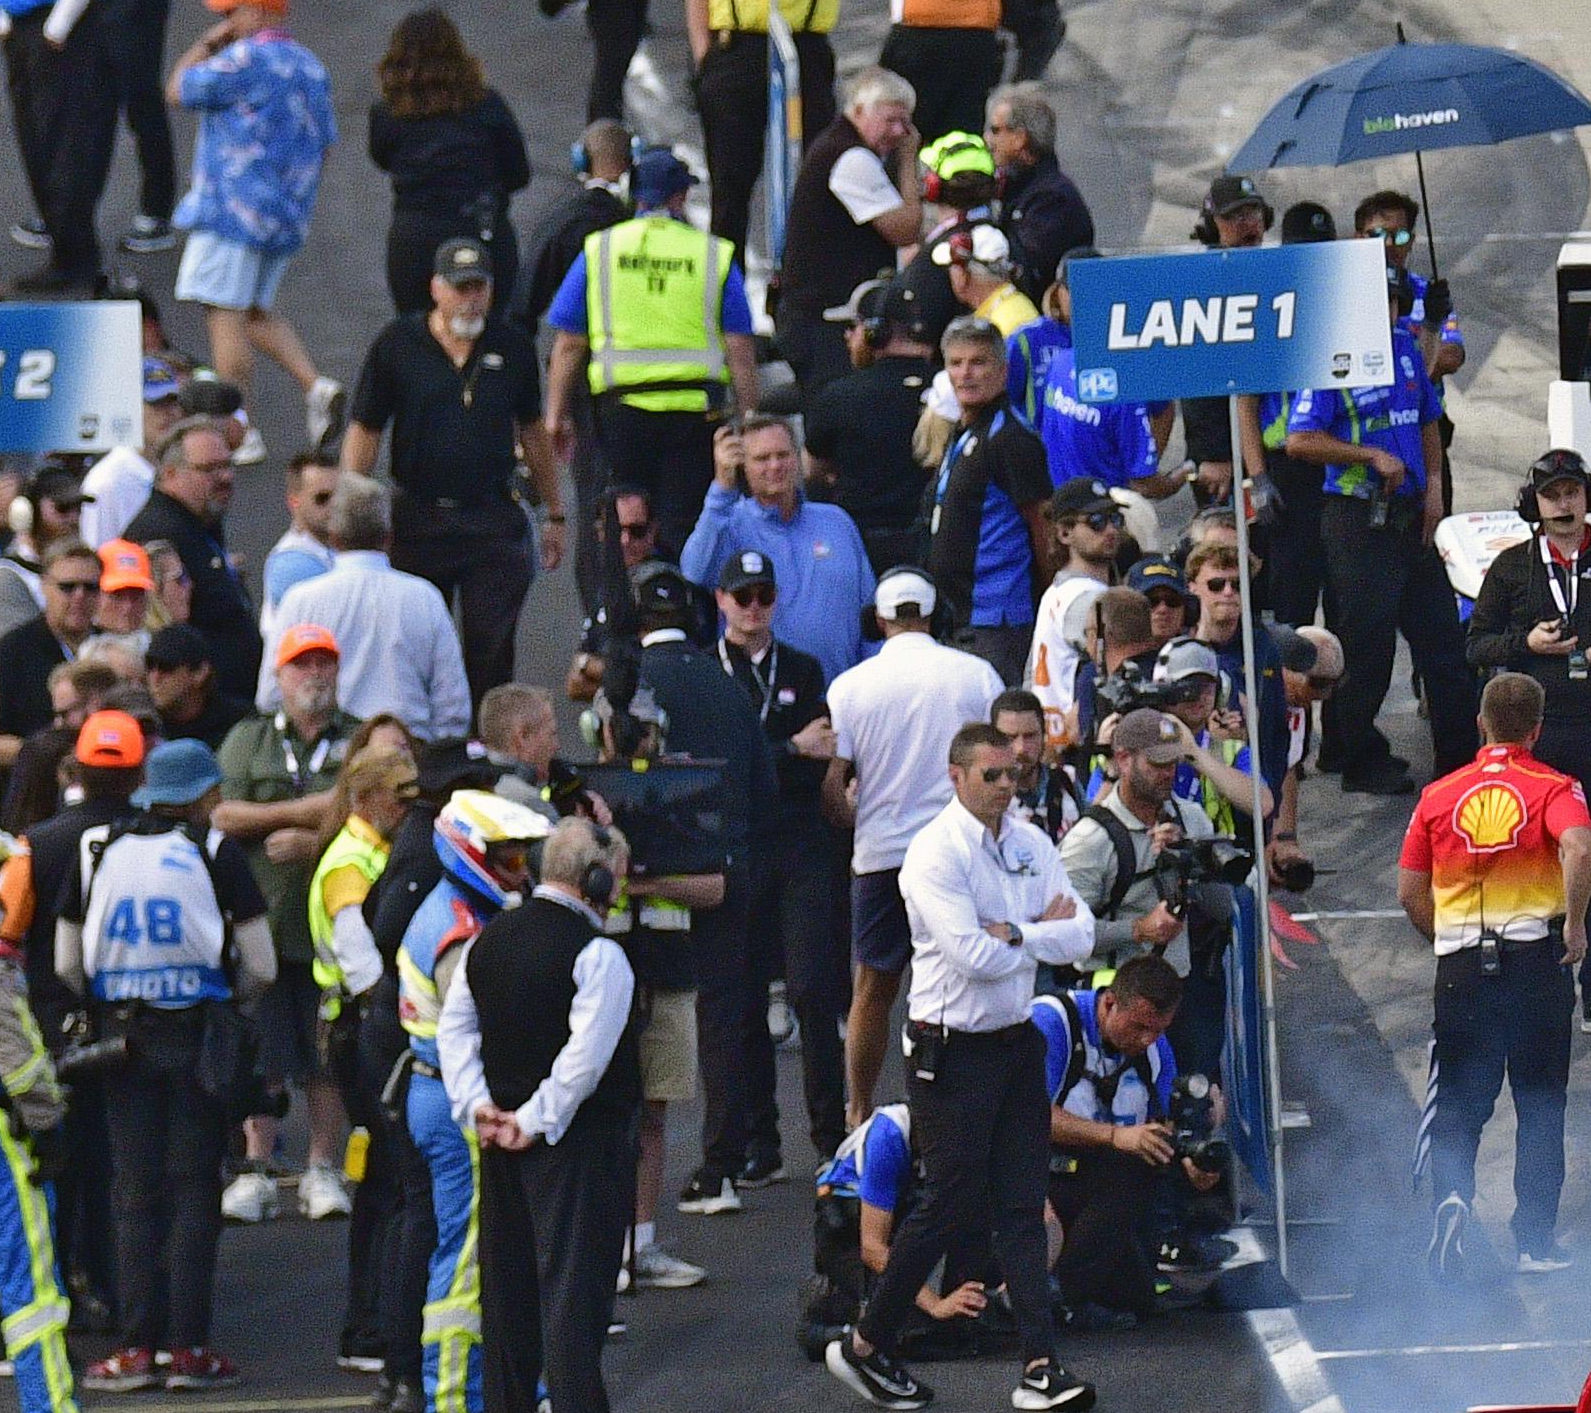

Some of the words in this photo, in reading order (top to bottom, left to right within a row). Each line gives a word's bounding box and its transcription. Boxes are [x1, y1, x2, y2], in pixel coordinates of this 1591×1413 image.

[1363, 108, 1459, 135] biohaven
[1107, 293, 1259, 350] LANE
[1272, 290, 1296, 339] 1
[14, 348, 56, 401] 2
